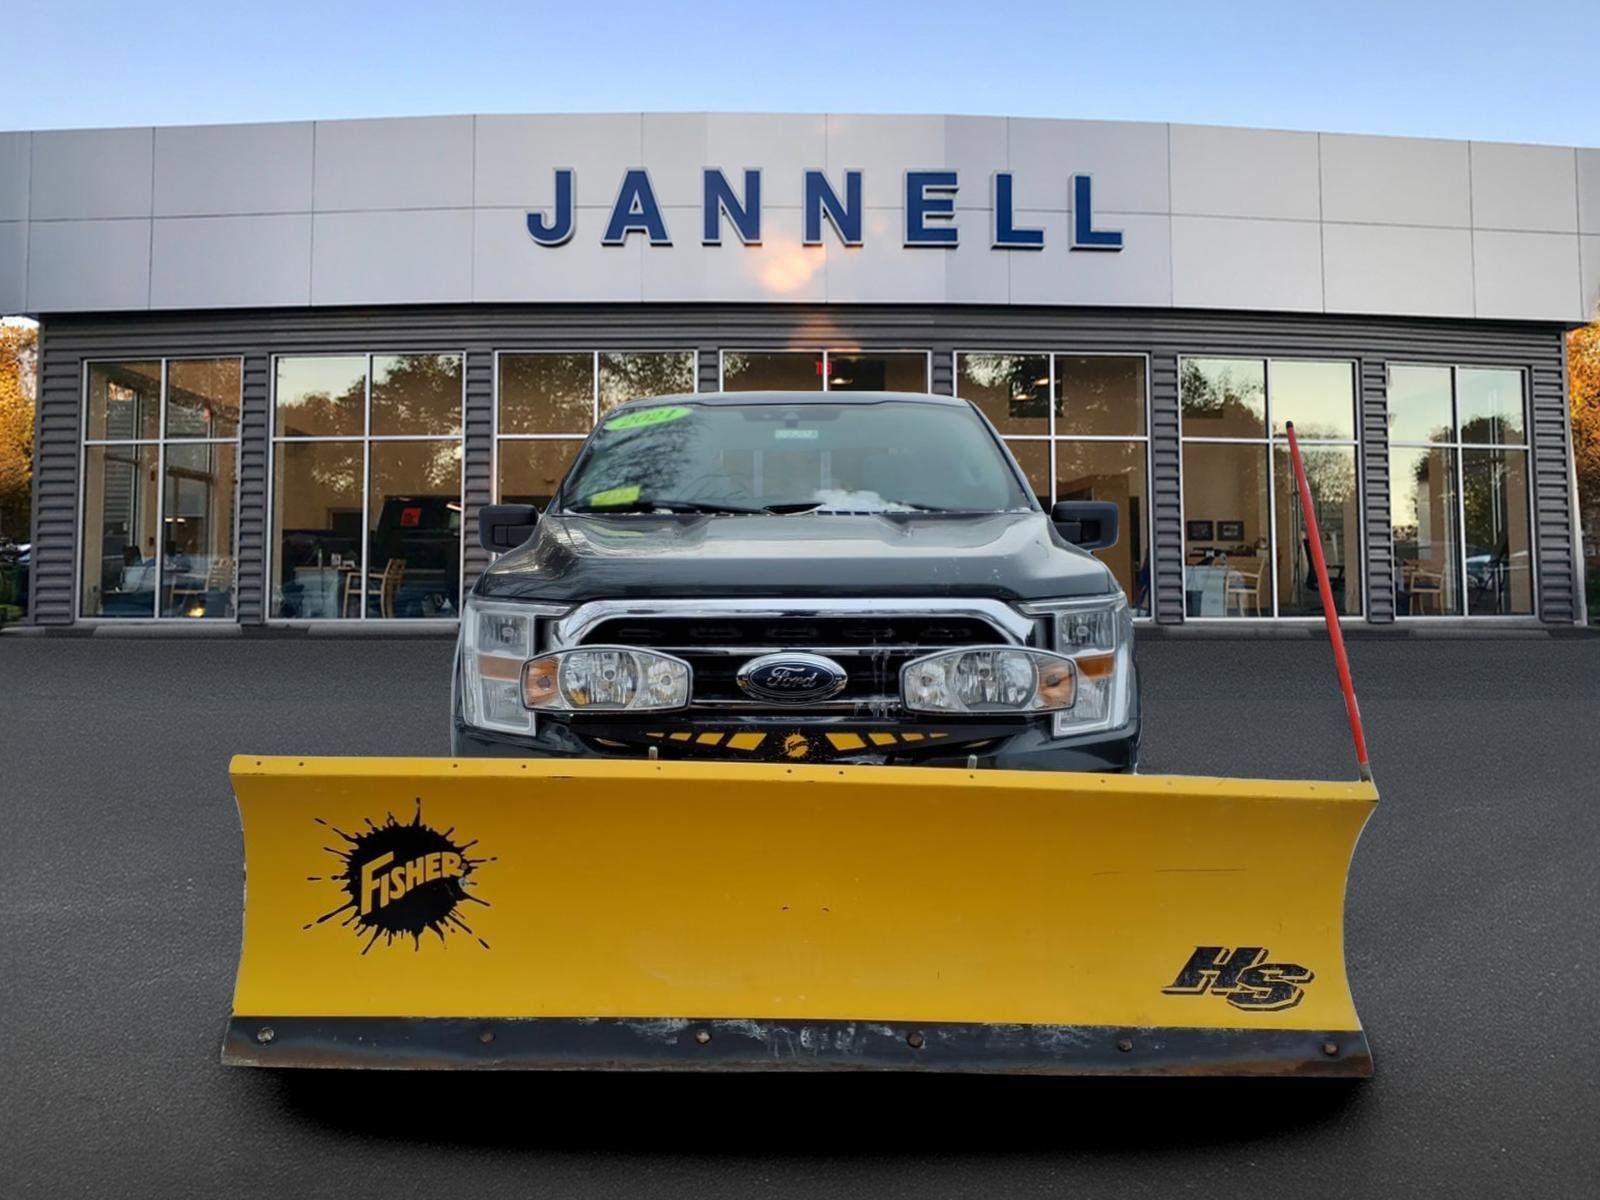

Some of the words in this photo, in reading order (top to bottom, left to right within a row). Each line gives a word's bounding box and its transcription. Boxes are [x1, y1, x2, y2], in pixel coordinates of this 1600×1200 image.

[526, 167, 1123, 250] JANNELL
[766, 666, 818, 688] Ford
[361, 851, 464, 916] FISHER
[1161, 947, 1315, 1012] HS
